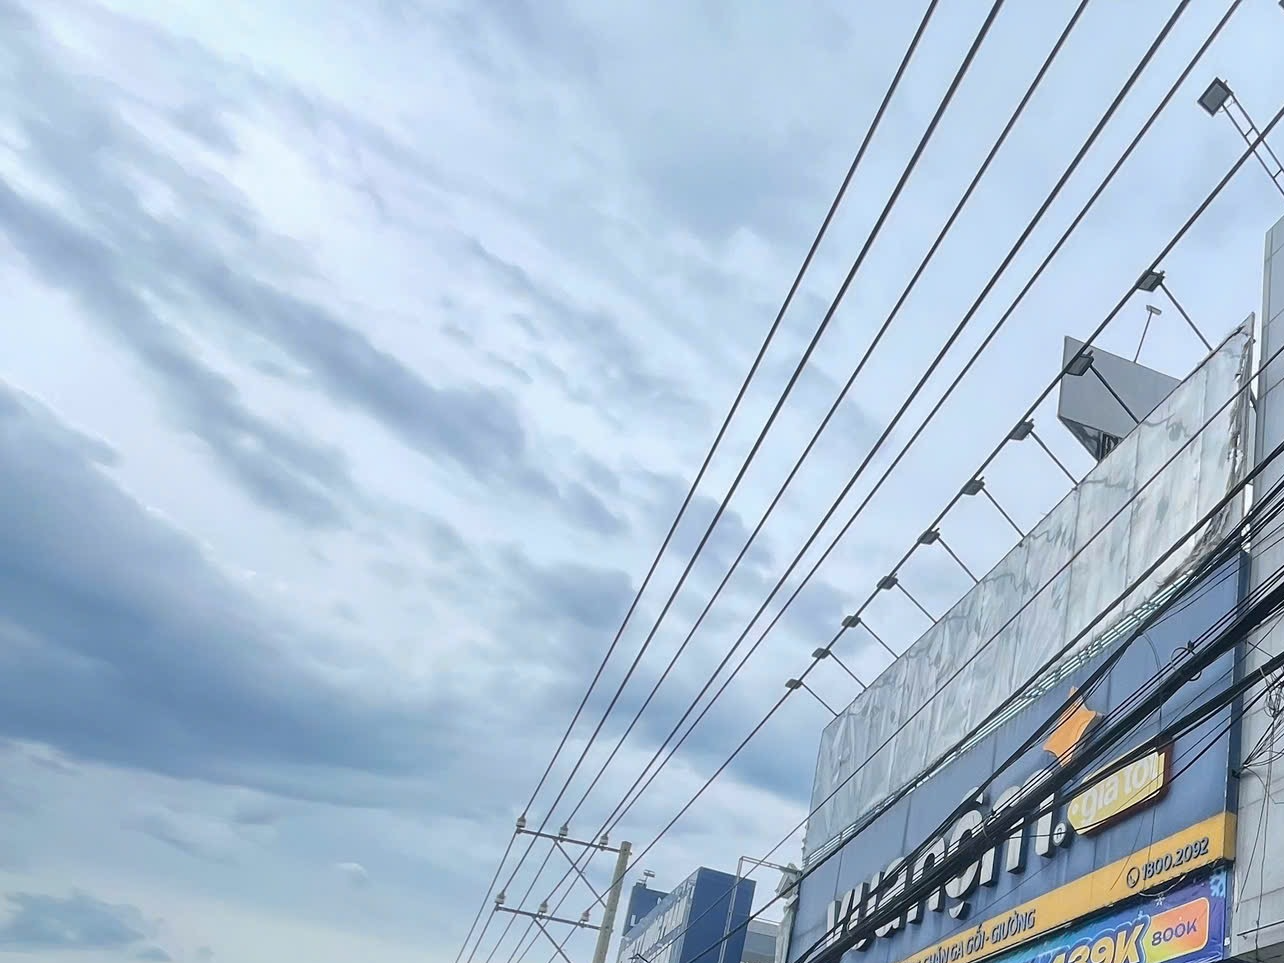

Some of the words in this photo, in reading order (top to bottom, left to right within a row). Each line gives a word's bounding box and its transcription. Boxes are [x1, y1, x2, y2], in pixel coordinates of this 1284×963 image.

[1141, 837, 1210, 881] 1800.2092
[949, 942, 964, 963] GA
[967, 924, 985, 955] GỐI
[991, 909, 1037, 945] GIƯỜNG
[1151, 919, 1199, 946] 800K
